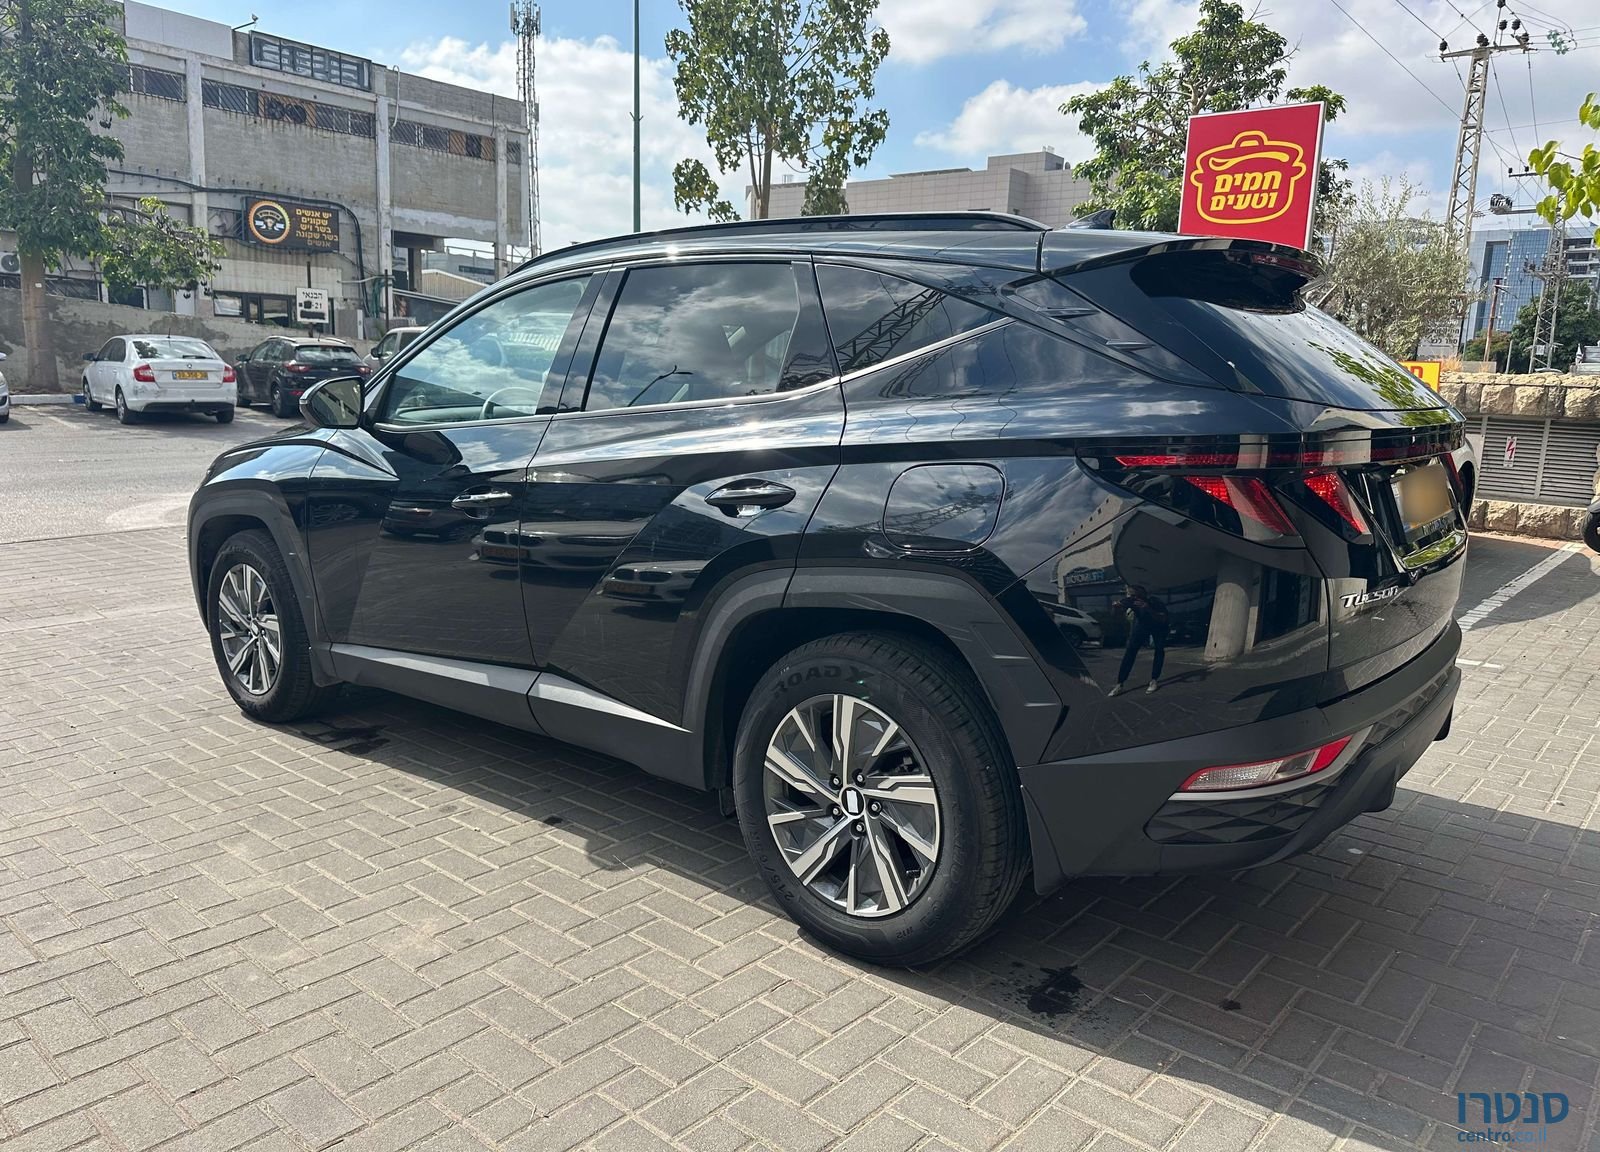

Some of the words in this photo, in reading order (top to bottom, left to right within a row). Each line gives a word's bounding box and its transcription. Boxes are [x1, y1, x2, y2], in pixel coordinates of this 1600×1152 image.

[1214, 171, 1282, 193] חמים
[1210, 192, 1278, 211] וטעים
[295, 208, 321, 217] אנשים
[301, 217, 328, 225] שקונים
[300, 223, 313, 231] ויש
[315, 226, 332, 234] בשר
